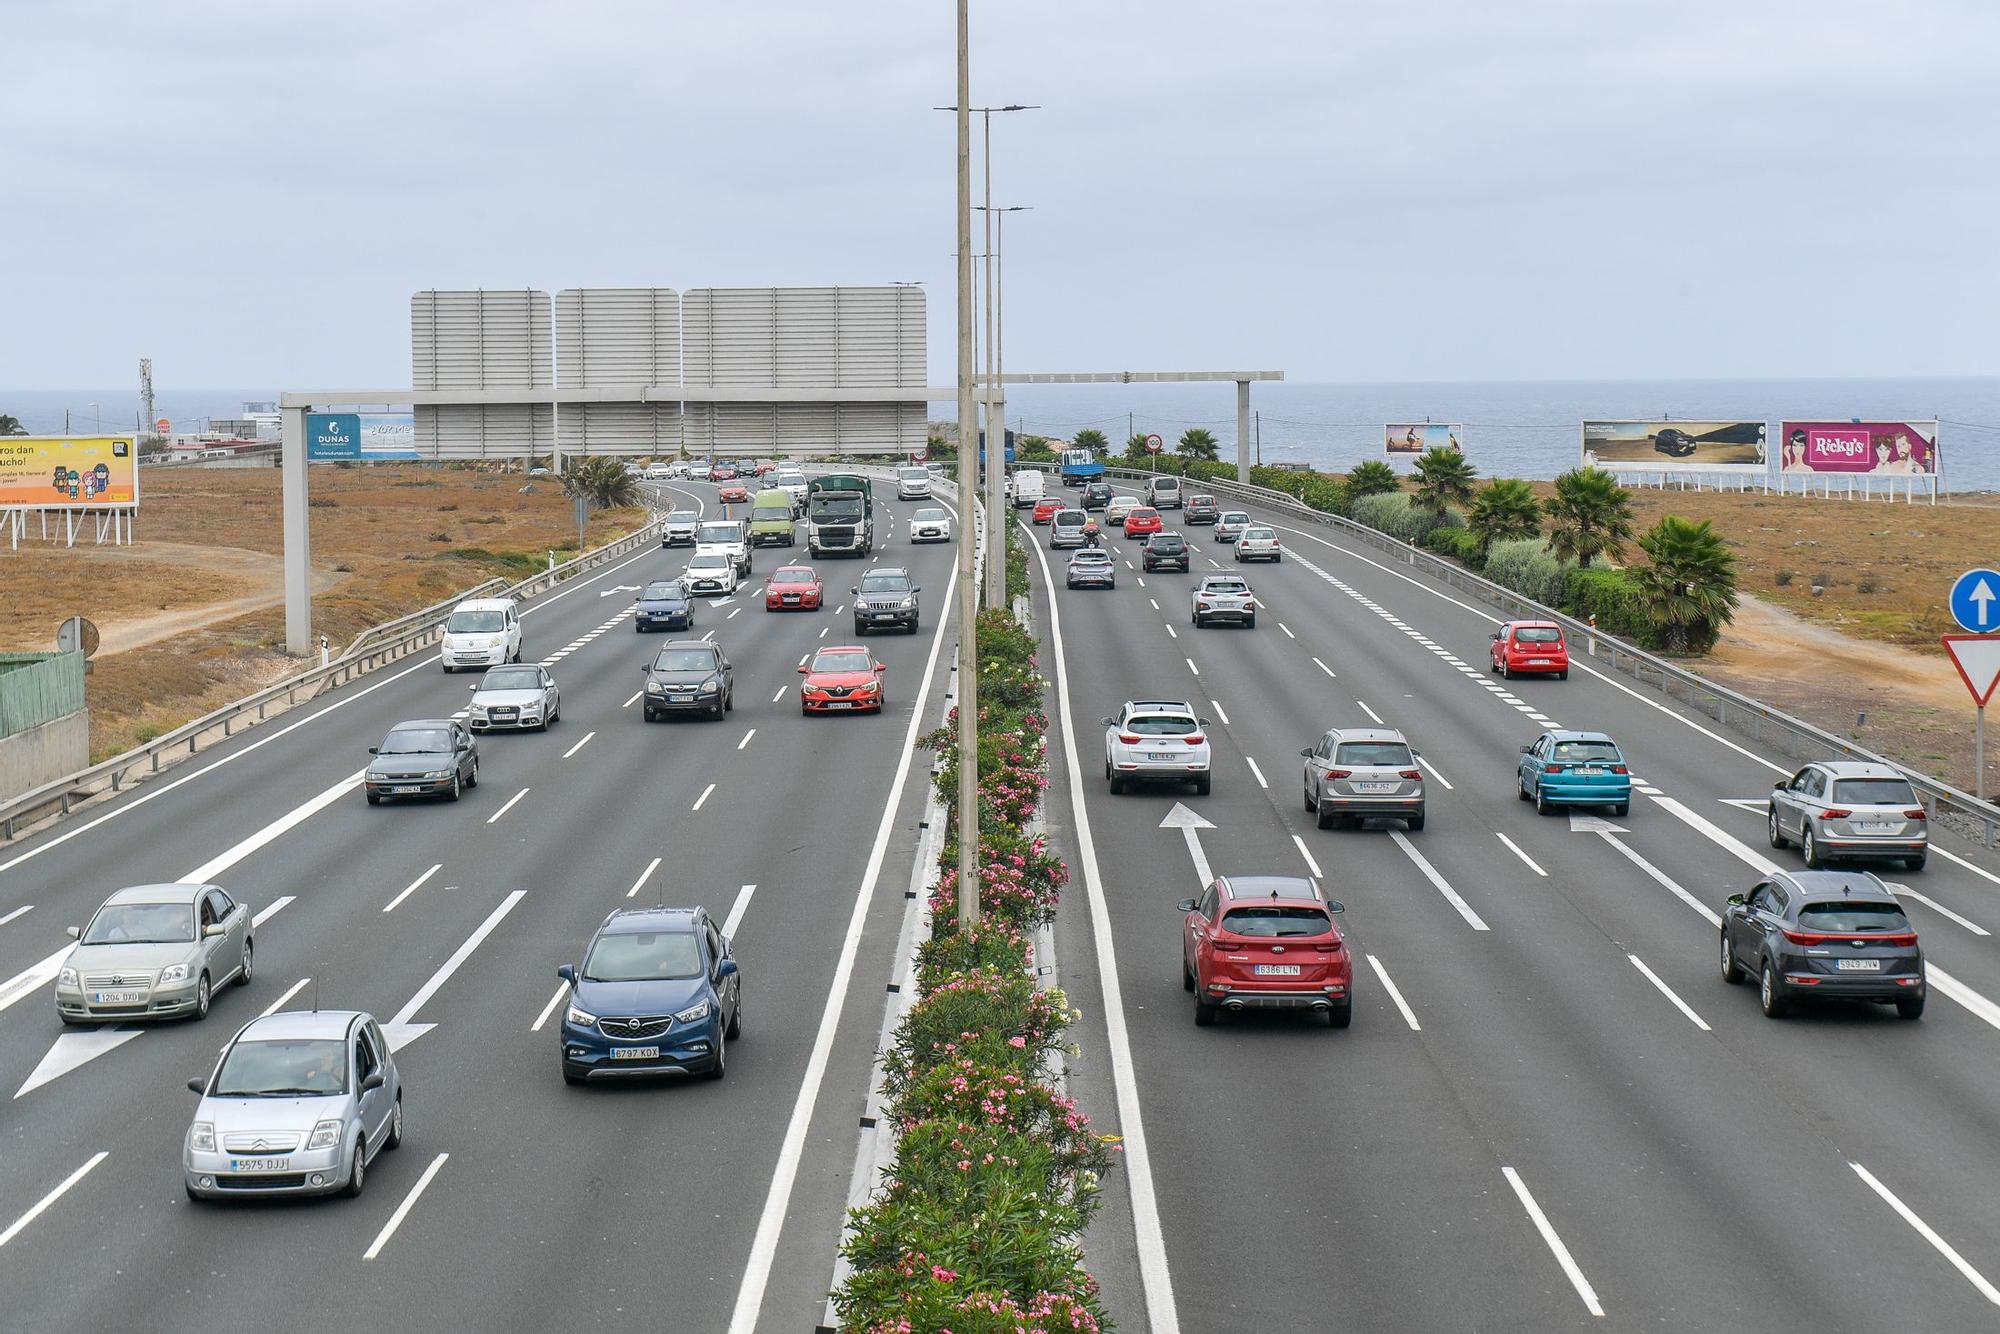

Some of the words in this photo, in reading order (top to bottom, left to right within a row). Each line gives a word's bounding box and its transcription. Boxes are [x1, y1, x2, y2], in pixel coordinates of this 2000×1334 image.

[17, 446, 34, 454] dan
[1815, 438, 1864, 456] Ricky's
[1261, 965, 1280, 973] 6386
[1283, 965, 1298, 973] LTN
[640, 1048, 658, 1057] KDX
[240, 1160, 264, 1170] 5575
